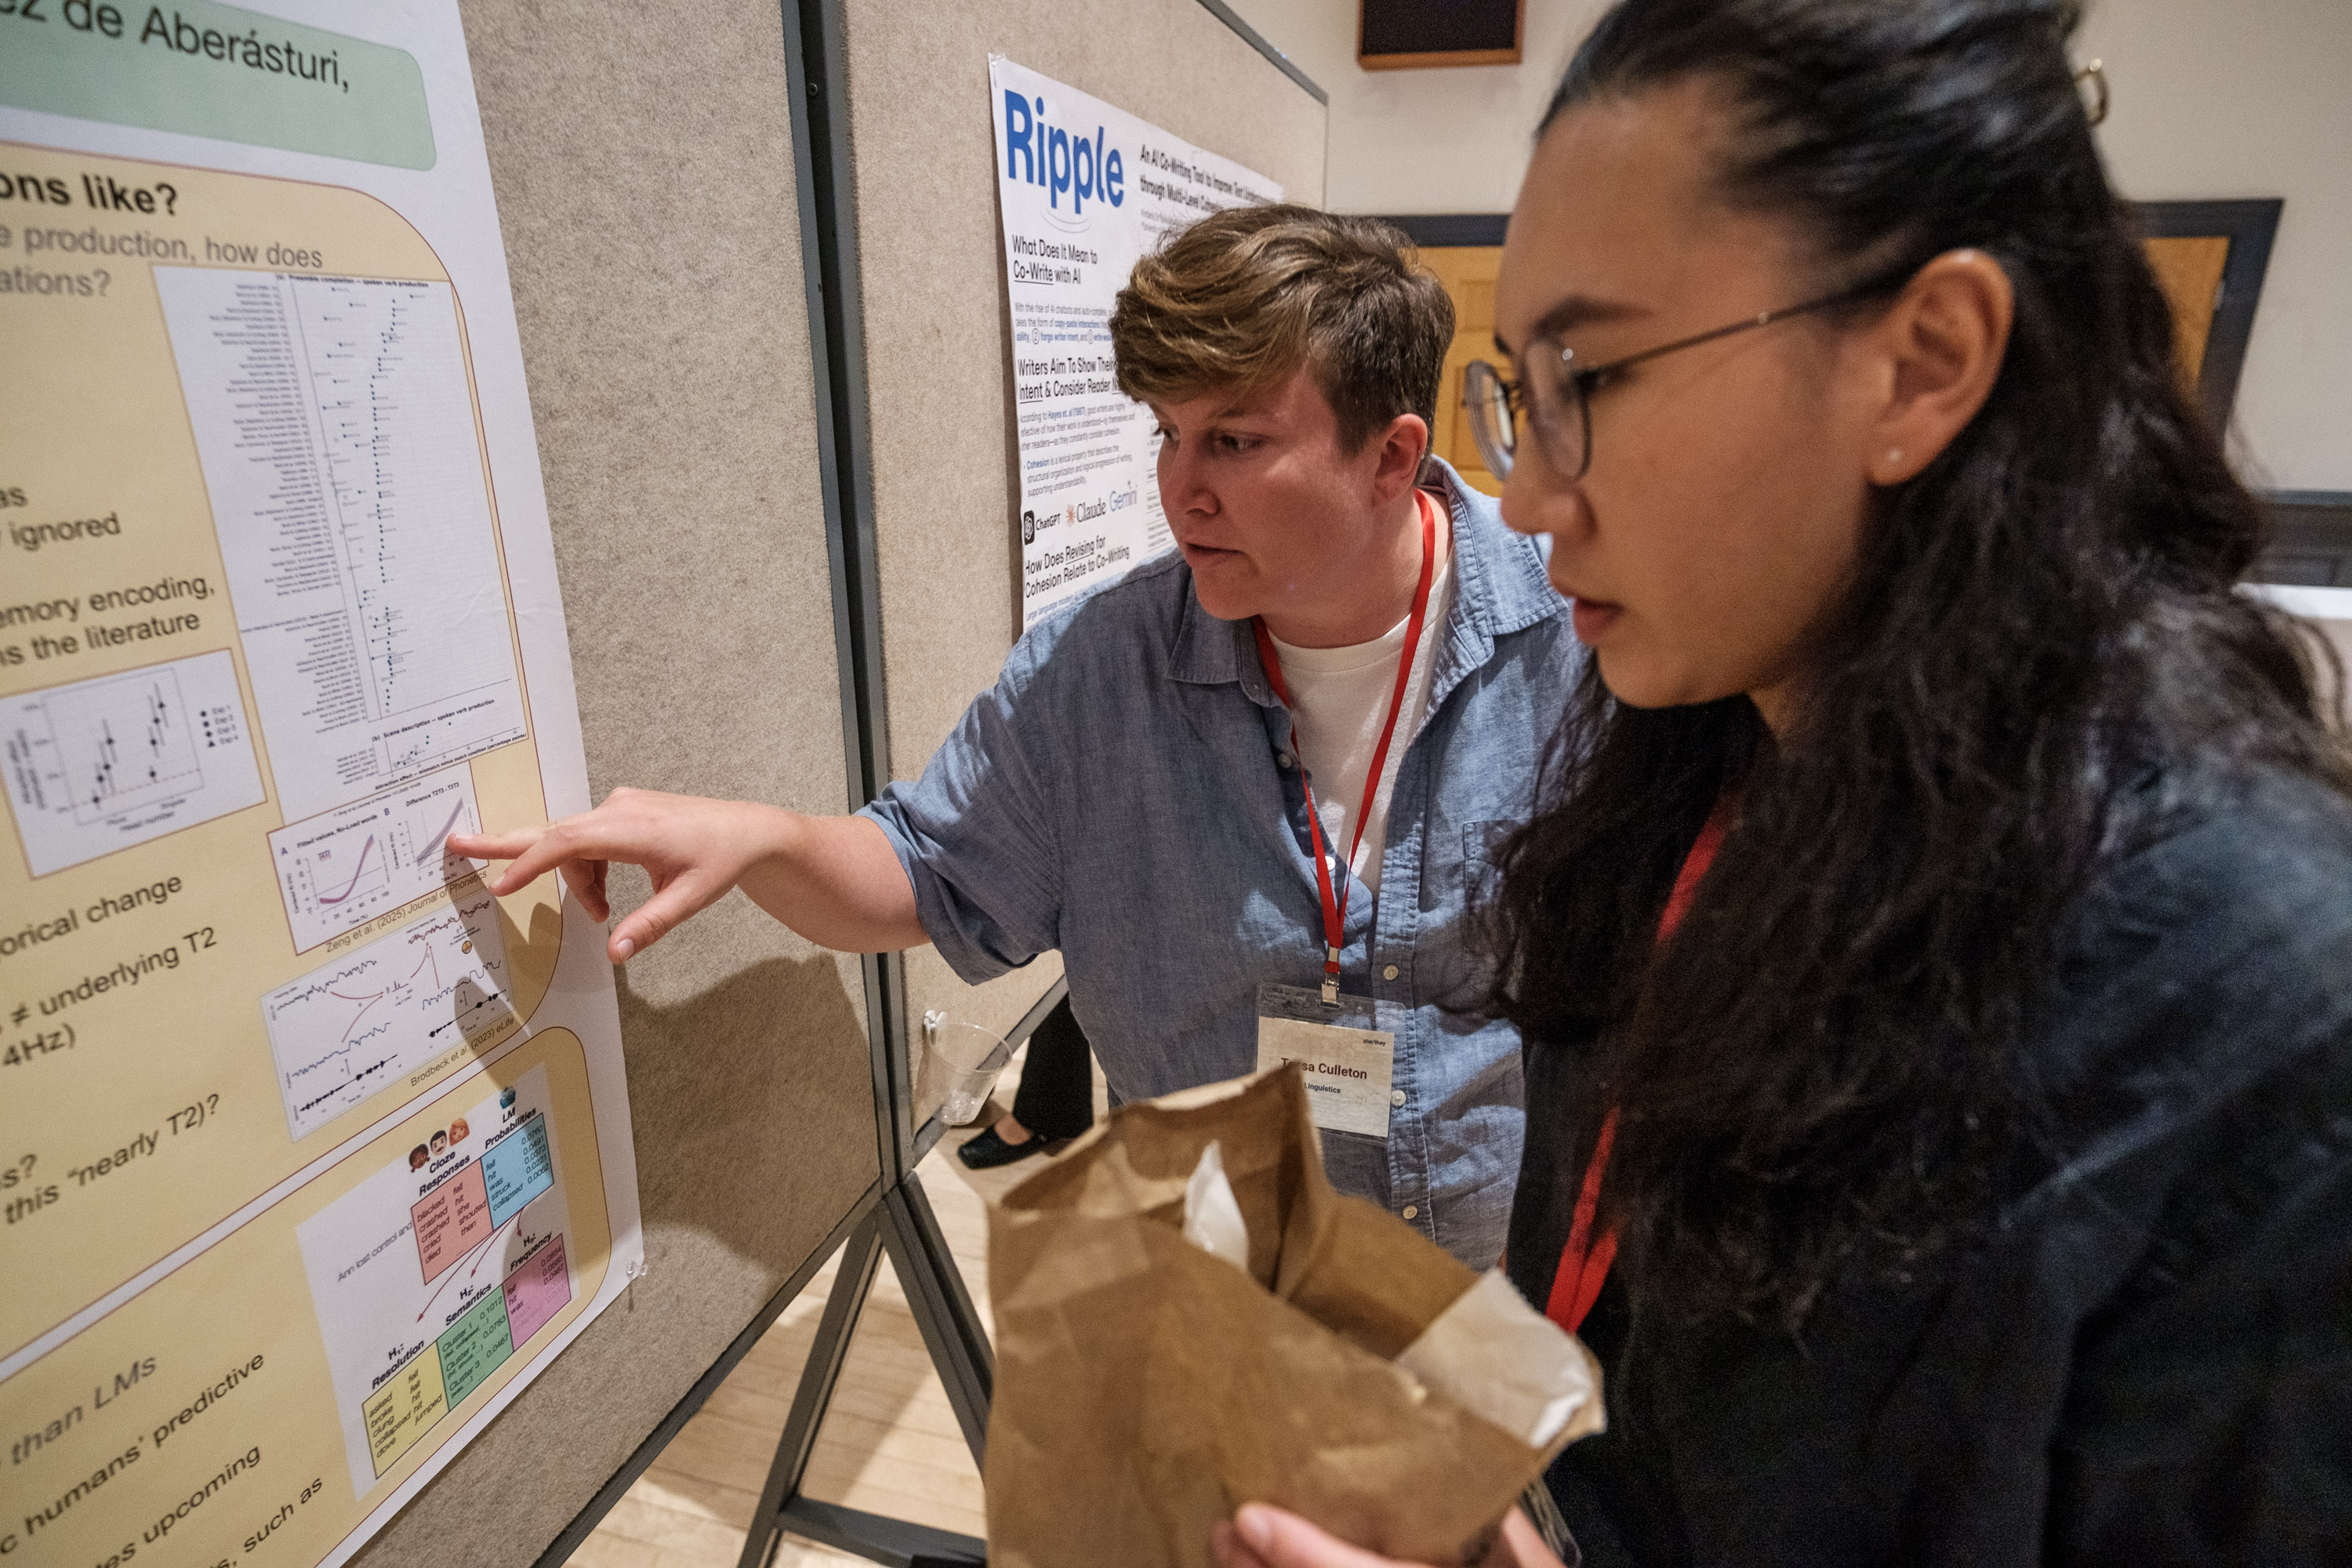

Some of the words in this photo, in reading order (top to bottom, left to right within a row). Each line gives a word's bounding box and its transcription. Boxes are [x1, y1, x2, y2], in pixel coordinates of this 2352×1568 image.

[63, 0, 123, 38] de
[140, 6, 350, 93] Aberásturi,
[1004, 89, 1124, 215] Ripple
[82, 172, 177, 216] like?
[24, 227, 195, 265] production,
[205, 235, 260, 263] how
[266, 241, 324, 269] does
[1012, 234, 1037, 256] What
[1039, 238, 1060, 259] Does
[1061, 243, 1067, 260] It
[1068, 244, 1090, 263] Mean
[1090, 249, 1098, 265] to
[1014, 260, 1053, 282] Co-Write
[1054, 267, 1071, 284] with
[1073, 267, 1080, 285] AI
[1018, 358, 1048, 376] Writers
[1051, 358, 1066, 375] Aim
[1067, 358, 1076, 373] To
[1077, 357, 1097, 373] Show
[1019, 383, 1044, 401] Intent
[1053, 379, 1087, 397] Consider
[1087, 378, 1111, 394] Reader
[1026, 458, 1050, 470] Cohesion
[1036, 513, 1062, 531] ChatGPT
[1076, 497, 1107, 523] Claude
[8, 511, 121, 552] ignored
[1025, 559, 1043, 576] How
[1044, 552, 1064, 570] Does
[1065, 539, 1094, 562] Revising
[1096, 535, 1105, 550] for
[89, 576, 216, 612] encoding,
[1025, 573, 1062, 599] Cohesion
[1063, 562, 1087, 583] Relate
[1087, 558, 1095, 573] to
[31, 635, 80, 661] the
[84, 612, 201, 650] literature
[383, 728, 401, 739] Scene
[401, 718, 431, 734] description
[437, 710, 456, 722] spoken
[456, 706, 468, 716] verb
[468, 698, 495, 713] production
[384, 808, 390, 816] B
[405, 793, 431, 808] Difference
[0, 908, 79, 956] orical
[86, 876, 183, 924] change
[326, 935, 351, 953] Zeng
[353, 929, 362, 939] et
[364, 924, 376, 935] al.
[377, 908, 406, 931] (2025)
[408, 893, 437, 914] Journal
[440, 887, 449, 899] of
[449, 870, 488, 895] Phonetics
[39, 946, 181, 1016] underlying
[183, 926, 217, 954] T2
[410, 1058, 449, 1087] Brodbeck
[451, 1051, 459, 1062] et
[460, 1045, 470, 1056] al.
[470, 1027, 495, 1051] (2023)
[495, 1017, 515, 1033] eLife
[1363, 1038, 1386, 1047] she/they
[1280, 1057, 1315, 1072] Tsa
[1318, 1062, 1368, 1080] Culleton
[1304, 1081, 1341, 1094] Linguistics
[485, 1106, 537, 1150] Probabilities
[502, 1106, 516, 1123] LM
[5, 1184, 60, 1225] this
[166, 1093, 220, 1136] T2)?
[419, 1154, 471, 1197] Responses
[428, 1150, 456, 1174] Cloze
[488, 1170, 496, 1183] hit
[416, 1194, 445, 1223] blacked
[452, 1181, 464, 1196] fell
[488, 1177, 503, 1192] was
[491, 1181, 511, 1202] struck
[492, 1181, 524, 1212] collapsed
[419, 1205, 448, 1233] crashed
[455, 1193, 465, 1207] hit
[421, 1215, 451, 1244] crashed
[456, 1201, 470, 1216] she
[423, 1235, 442, 1254] cried
[459, 1197, 488, 1226] shouted
[337, 1265, 356, 1283] Ann
[356, 1252, 372, 1269] lost
[371, 1232, 397, 1258] control
[425, 1246, 442, 1265] died
[460, 1219, 477, 1237] then
[510, 1230, 553, 1272] Frequency
[441, 1327, 467, 1352] Cluster
[479, 1294, 503, 1320] 0.1012
[445, 1282, 492, 1327] Semantics
[510, 1299, 524, 1316] was
[372, 1339, 425, 1391] Resolution
[445, 1346, 470, 1372] Cluster
[471, 1341, 477, 1349] 2
[449, 1366, 474, 1392] Cluster
[475, 1359, 481, 1369] 3
[11, 1403, 84, 1467] than
[93, 1355, 158, 1410] LMs
[152, 1353, 265, 1449] predictive
[368, 1391, 394, 1418] asked
[408, 1367, 419, 1384] fell
[370, 1404, 394, 1429] broke
[410, 1378, 421, 1394] fell
[372, 1414, 395, 1439] clung
[374, 1410, 412, 1449] collapsed
[376, 1436, 397, 1458] dove
[414, 1392, 444, 1426] jumped
[143, 1446, 261, 1545] upcoming
[243, 1502, 296, 1554] such
[299, 1475, 324, 1506] as
